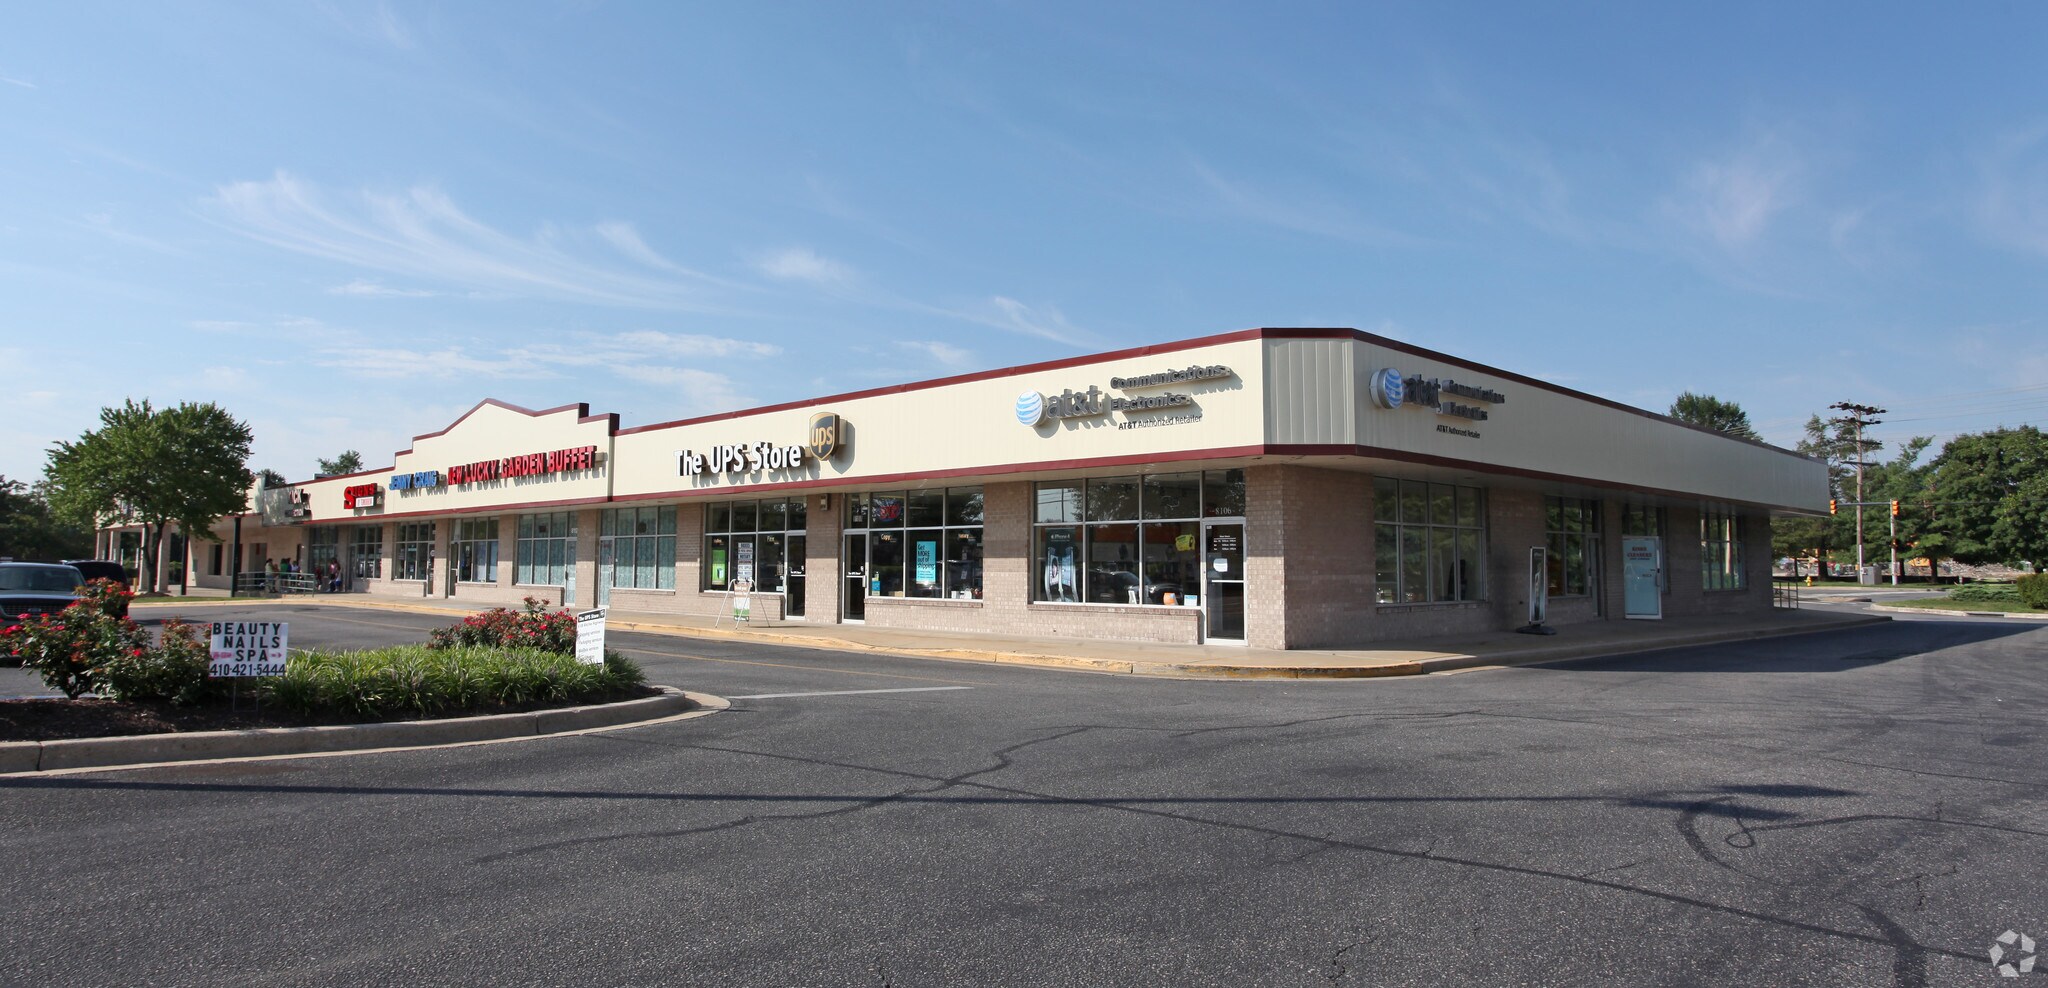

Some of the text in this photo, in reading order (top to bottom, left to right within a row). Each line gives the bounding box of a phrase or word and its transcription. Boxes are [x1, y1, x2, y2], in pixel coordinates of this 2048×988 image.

[1110, 364, 1224, 390] Communications
[1046, 385, 1103, 419] at&t
[1110, 392, 1185, 411] Electronics
[1118, 414, 1203, 430] AT&T Authorized Retailer
[811, 424, 833, 454] ups
[465, 459, 500, 483] LUCKY
[501, 452, 545, 479] GARDEN
[548, 445, 596, 473] BUFFET
[674, 441, 802, 477] The UPS Store
[389, 470, 437, 490] JENNY CRAIG
[1215, 506, 1232, 515] 8106
[213, 622, 281, 635] BEAUTY
[223, 636, 281, 648] NAILS
[235, 649, 268, 661] SPA
